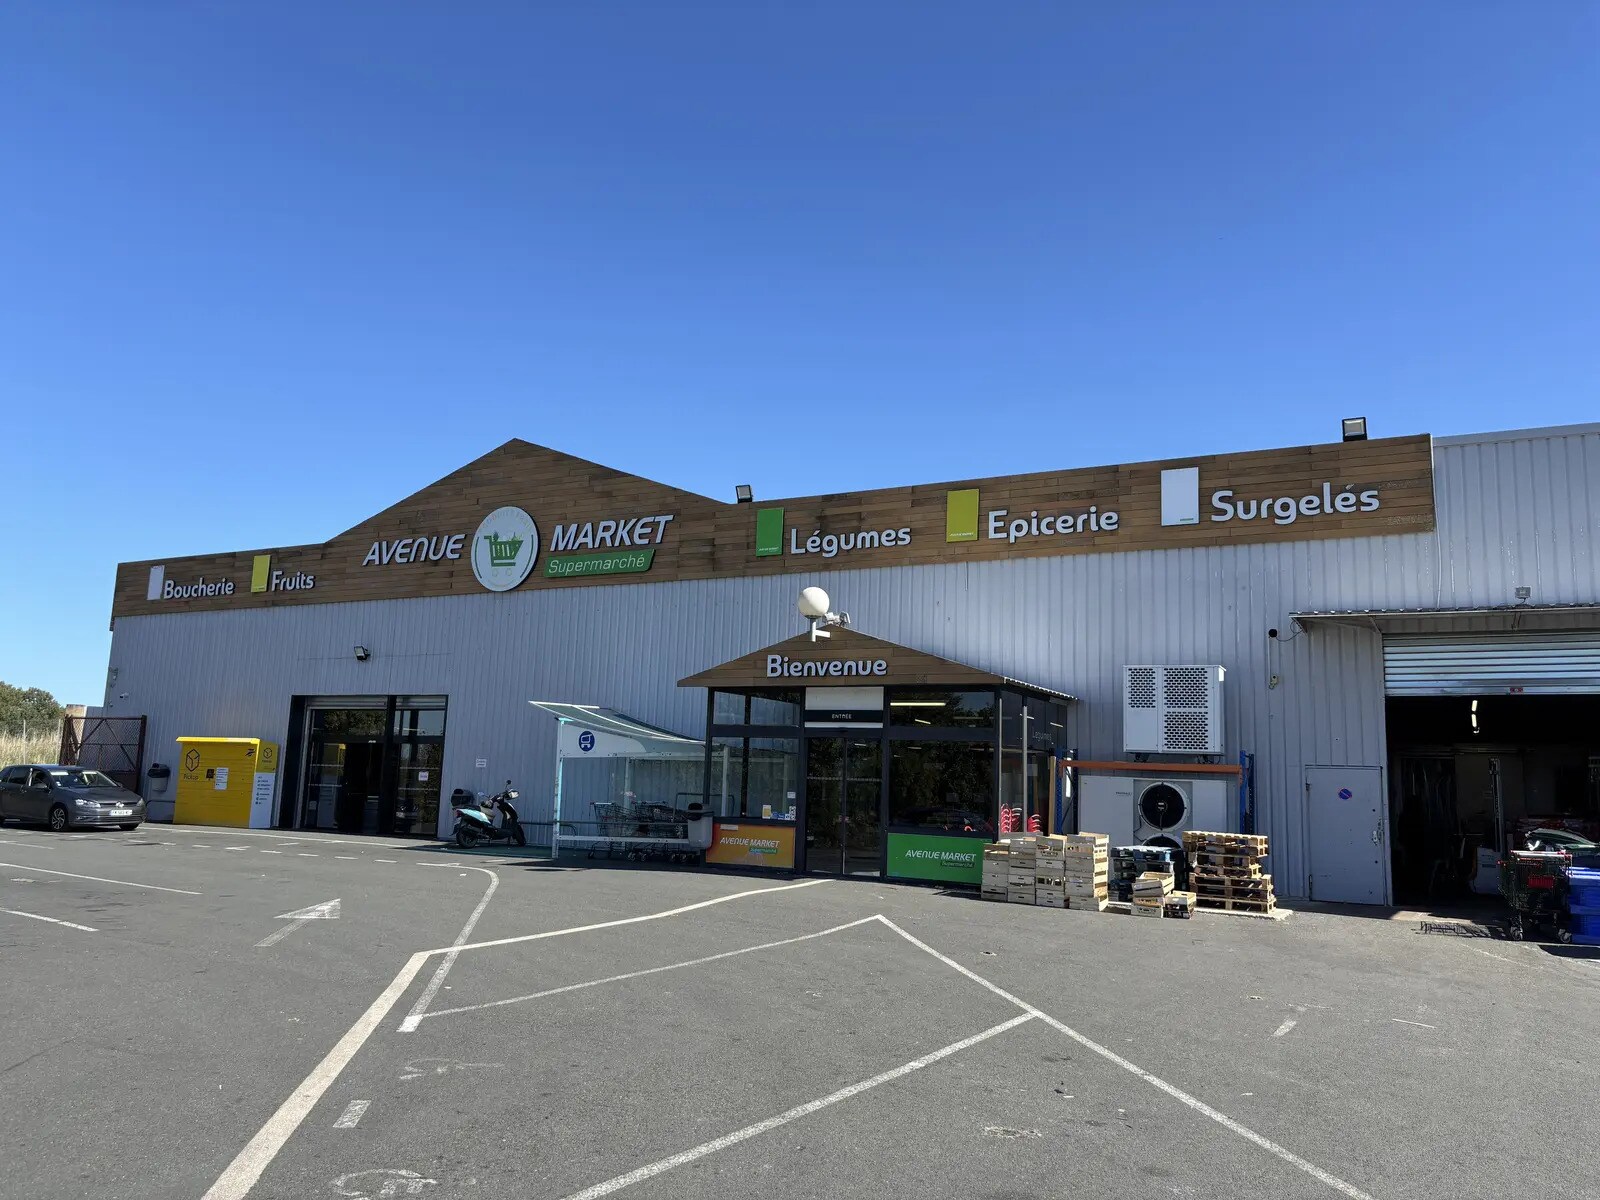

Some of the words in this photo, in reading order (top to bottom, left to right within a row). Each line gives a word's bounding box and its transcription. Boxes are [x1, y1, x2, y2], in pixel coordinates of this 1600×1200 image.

[1211, 482, 1381, 525] Surgelés
[987, 505, 1120, 544] Epicerie
[362, 533, 467, 566] AVENUE
[549, 514, 674, 552] MARKET
[790, 526, 912, 559] Légumes
[548, 554, 645, 576] Supermarché
[163, 577, 236, 600] Boucherie
[271, 570, 316, 592] Fruits
[766, 654, 888, 678] Bienvenue
[720, 837, 749, 846] AVENUE
[749, 839, 780, 848] MARKET
[905, 849, 940, 859] AVENUE
[940, 851, 977, 862] MARKET
